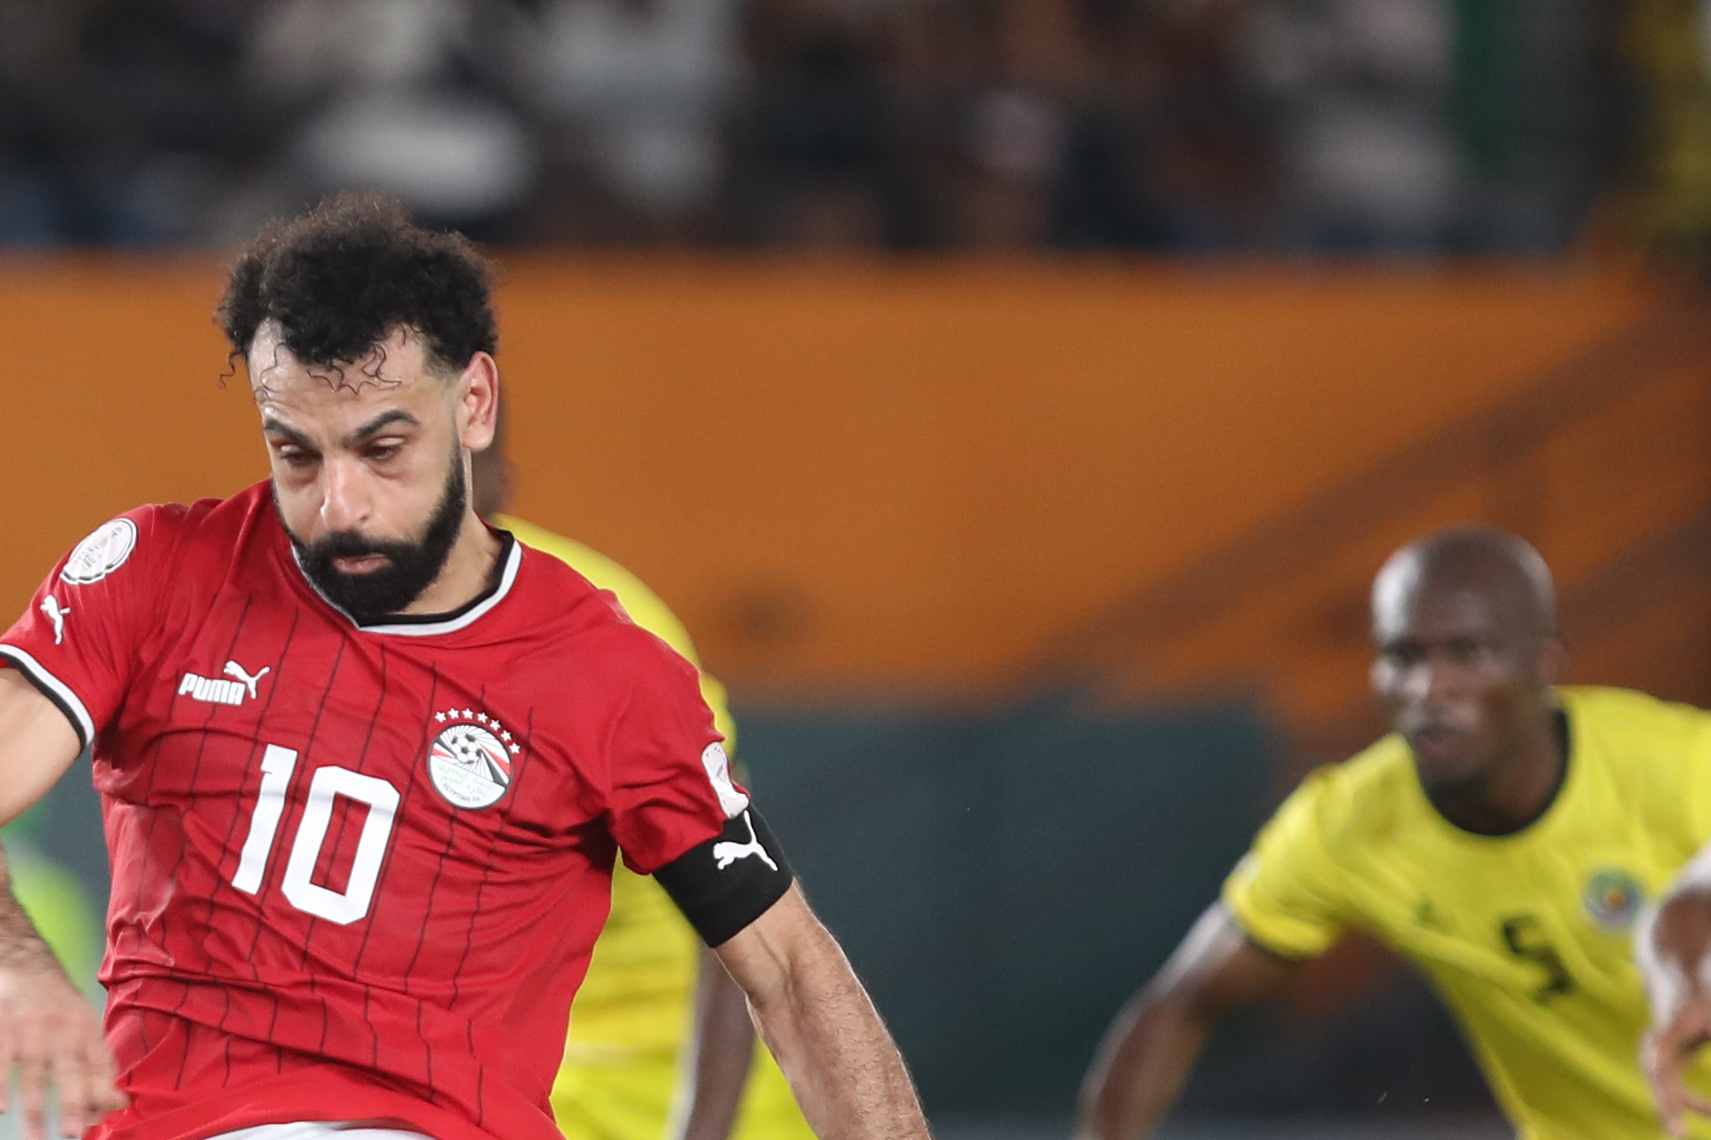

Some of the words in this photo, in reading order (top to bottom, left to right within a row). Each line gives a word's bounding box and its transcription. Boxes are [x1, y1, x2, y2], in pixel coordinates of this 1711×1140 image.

[177, 672, 247, 706] PUMA
[230, 742, 402, 926] 10
[1500, 912, 1575, 1004] 5
